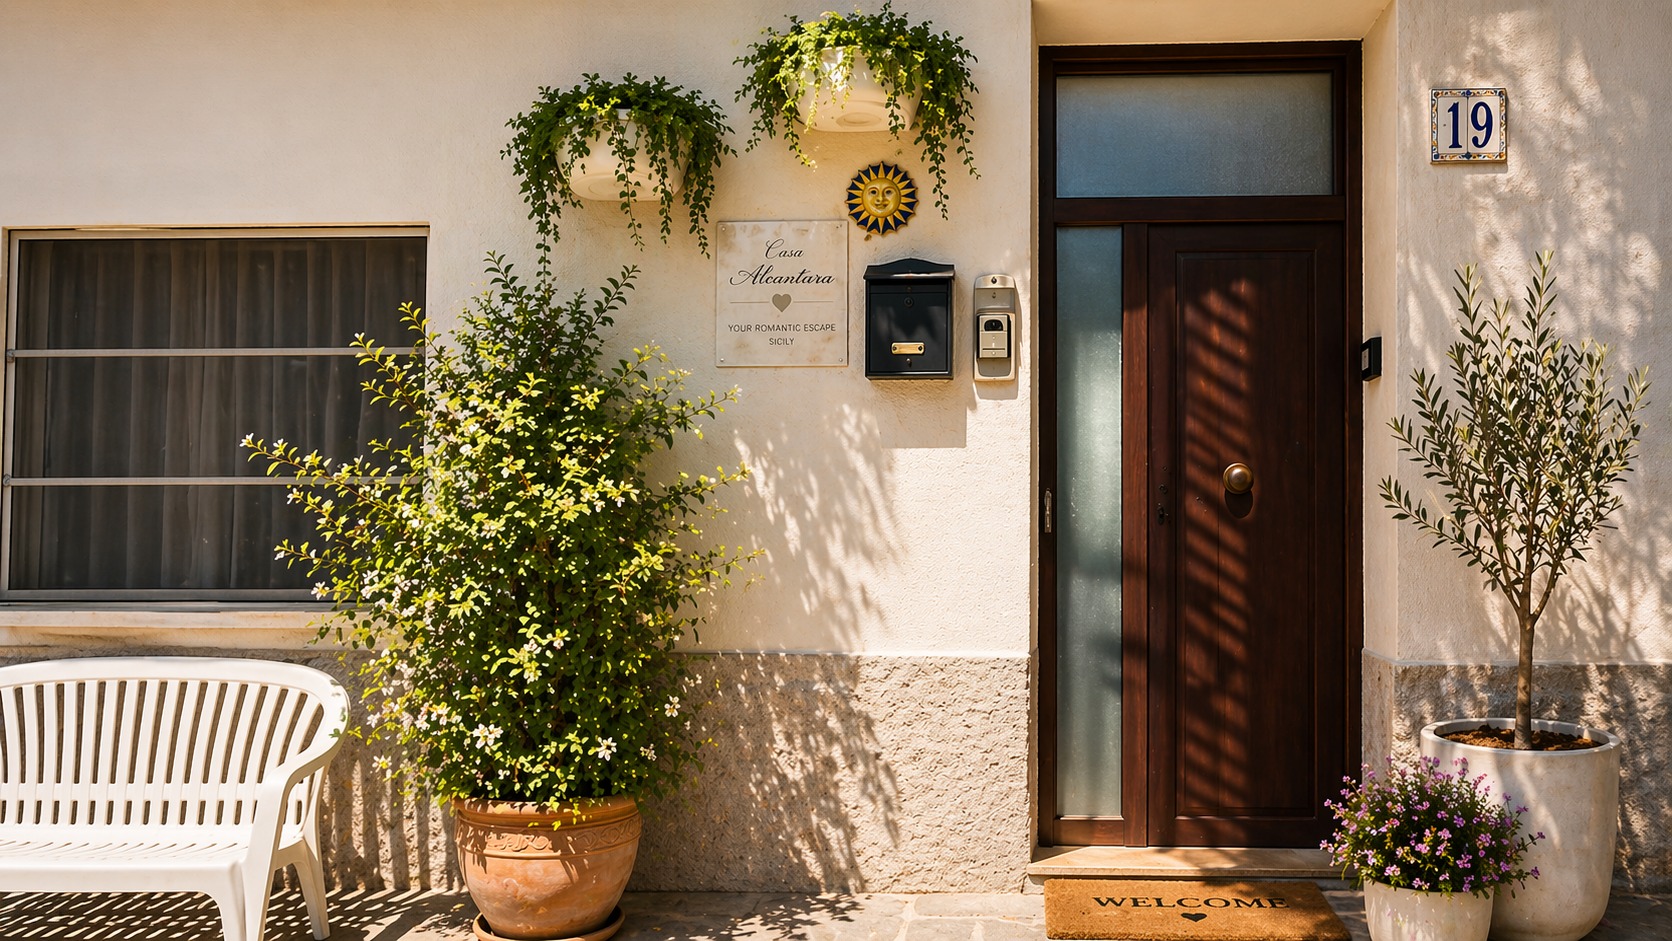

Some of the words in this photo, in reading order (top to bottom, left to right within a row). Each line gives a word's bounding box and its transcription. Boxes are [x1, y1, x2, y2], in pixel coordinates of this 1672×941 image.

[1447, 101, 1493, 149] 19
[765, 238, 804, 260] Casa
[729, 264, 835, 285] Alcantara
[728, 324, 753, 333] YOUR
[755, 324, 802, 333] ROMANTIC
[803, 323, 836, 332] ESCAPE
[769, 337, 795, 346] SICILY
[1093, 897, 1290, 908] WELCOME
